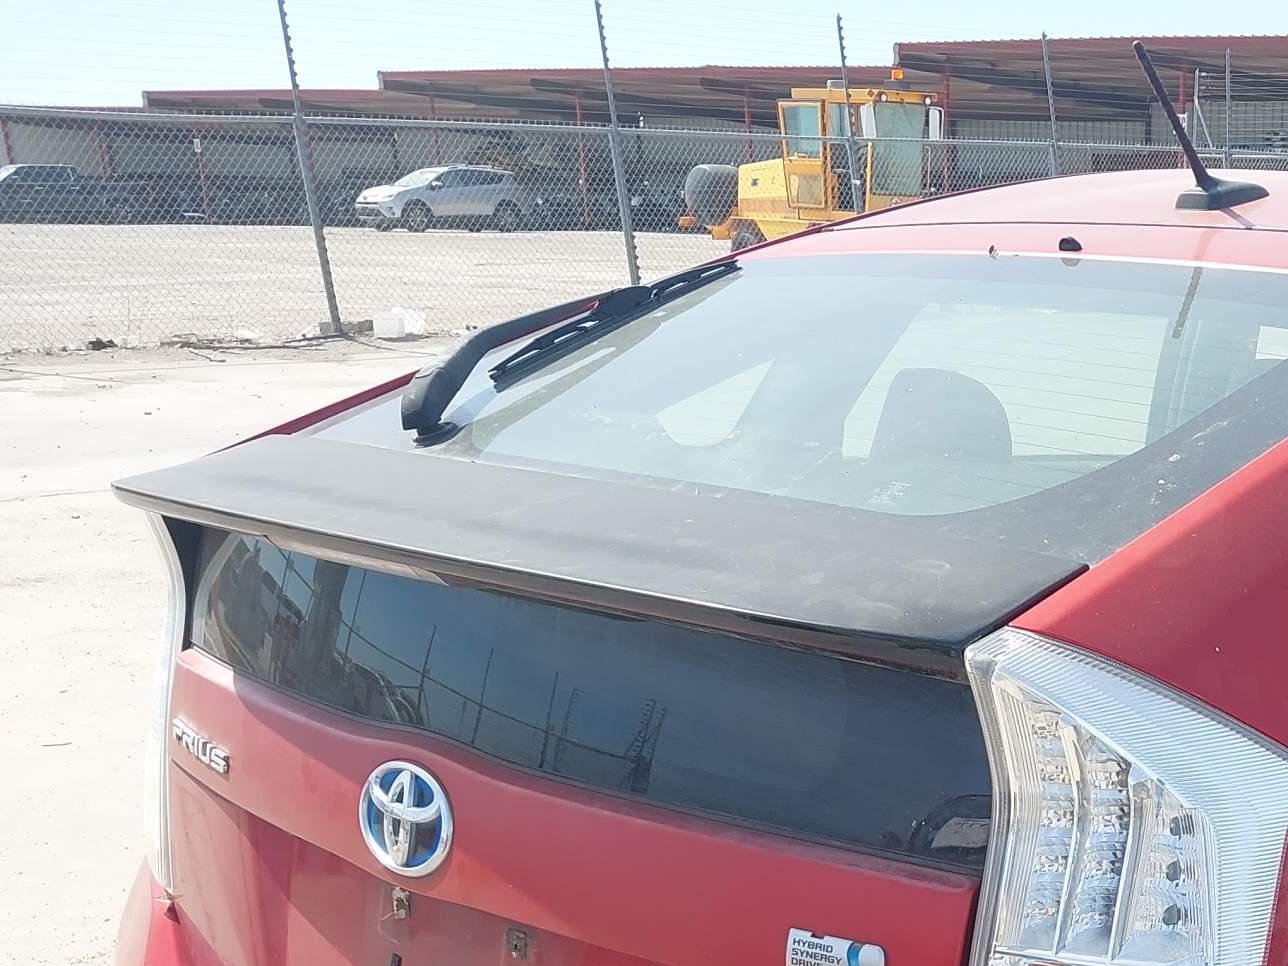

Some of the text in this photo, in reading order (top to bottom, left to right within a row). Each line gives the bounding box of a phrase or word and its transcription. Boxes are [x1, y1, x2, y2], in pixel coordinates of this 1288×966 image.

[172, 717, 230, 774] PRIUS
[792, 937, 833, 953] HYBRID
[791, 947, 842, 965] SYNERGY
